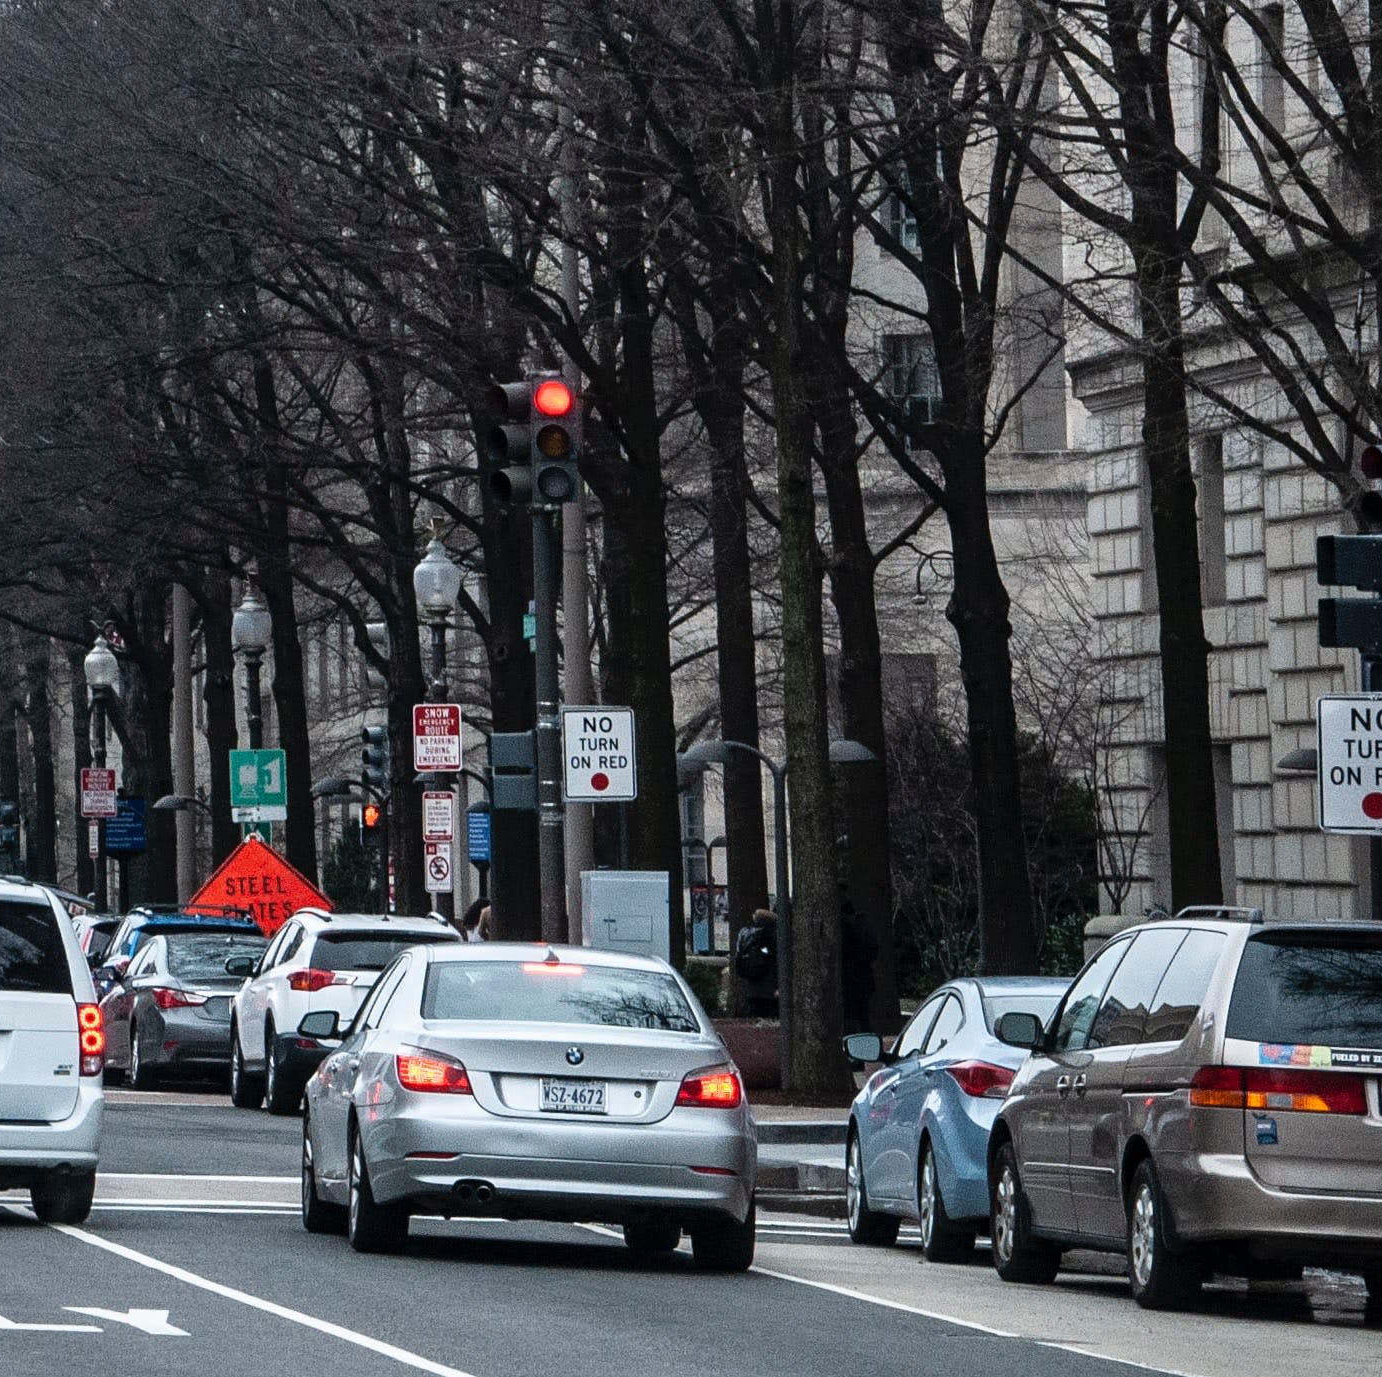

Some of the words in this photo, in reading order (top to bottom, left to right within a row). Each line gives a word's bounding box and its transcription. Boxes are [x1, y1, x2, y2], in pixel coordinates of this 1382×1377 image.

[424, 708, 450, 718] SNOW
[425, 726, 449, 735] ROUTE
[583, 716, 613, 733] NO
[579, 737, 619, 751] TURN
[571, 755, 591, 769] ON
[599, 755, 628, 769] RED
[1330, 766, 1362, 785] ON
[225, 876, 286, 895] STEEL
[1331, 1053, 1359, 1062] FUELED
[543, 1086, 603, 1105] WSZ-4672
